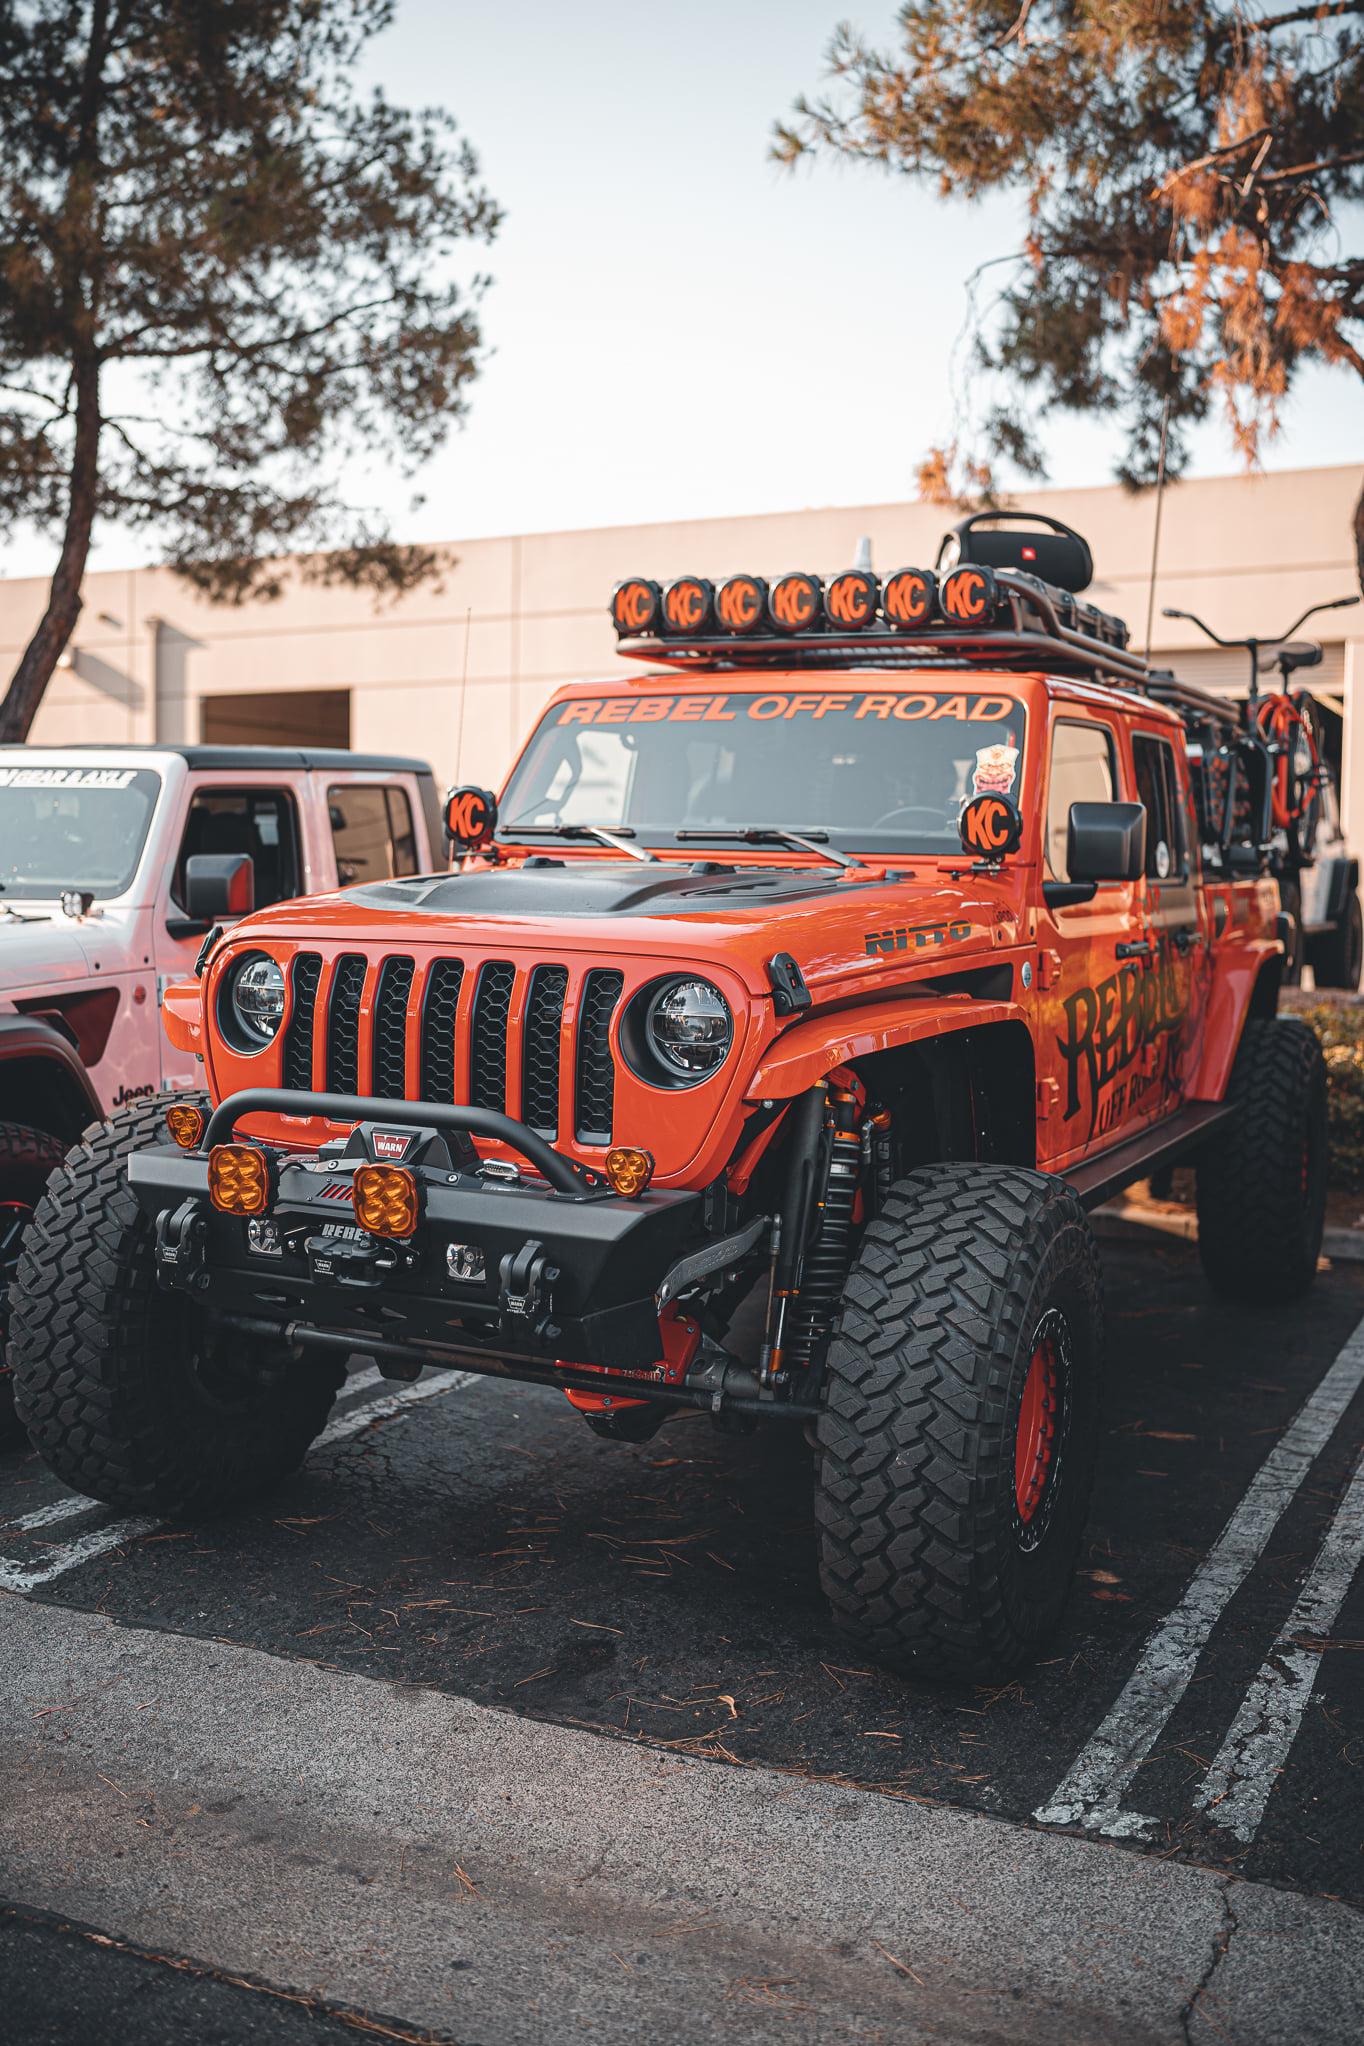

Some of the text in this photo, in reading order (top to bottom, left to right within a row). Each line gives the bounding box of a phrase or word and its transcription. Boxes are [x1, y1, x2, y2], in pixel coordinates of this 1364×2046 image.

[616, 584, 649, 627] KC
[668, 582, 702, 626] KC
[721, 580, 756, 625] KC
[774, 578, 812, 624] KC
[831, 576, 868, 622] KC
[887, 573, 925, 621] KC
[946, 572, 985, 618] KC
[557, 695, 1014, 725] REBEL OFF ROAD
[448, 793, 485, 838] KC
[967, 800, 1008, 850] KC
[864, 920, 970, 955] NITTO
[376, 1141, 403, 1153] WARN
[322, 1223, 370, 1241] REBE
